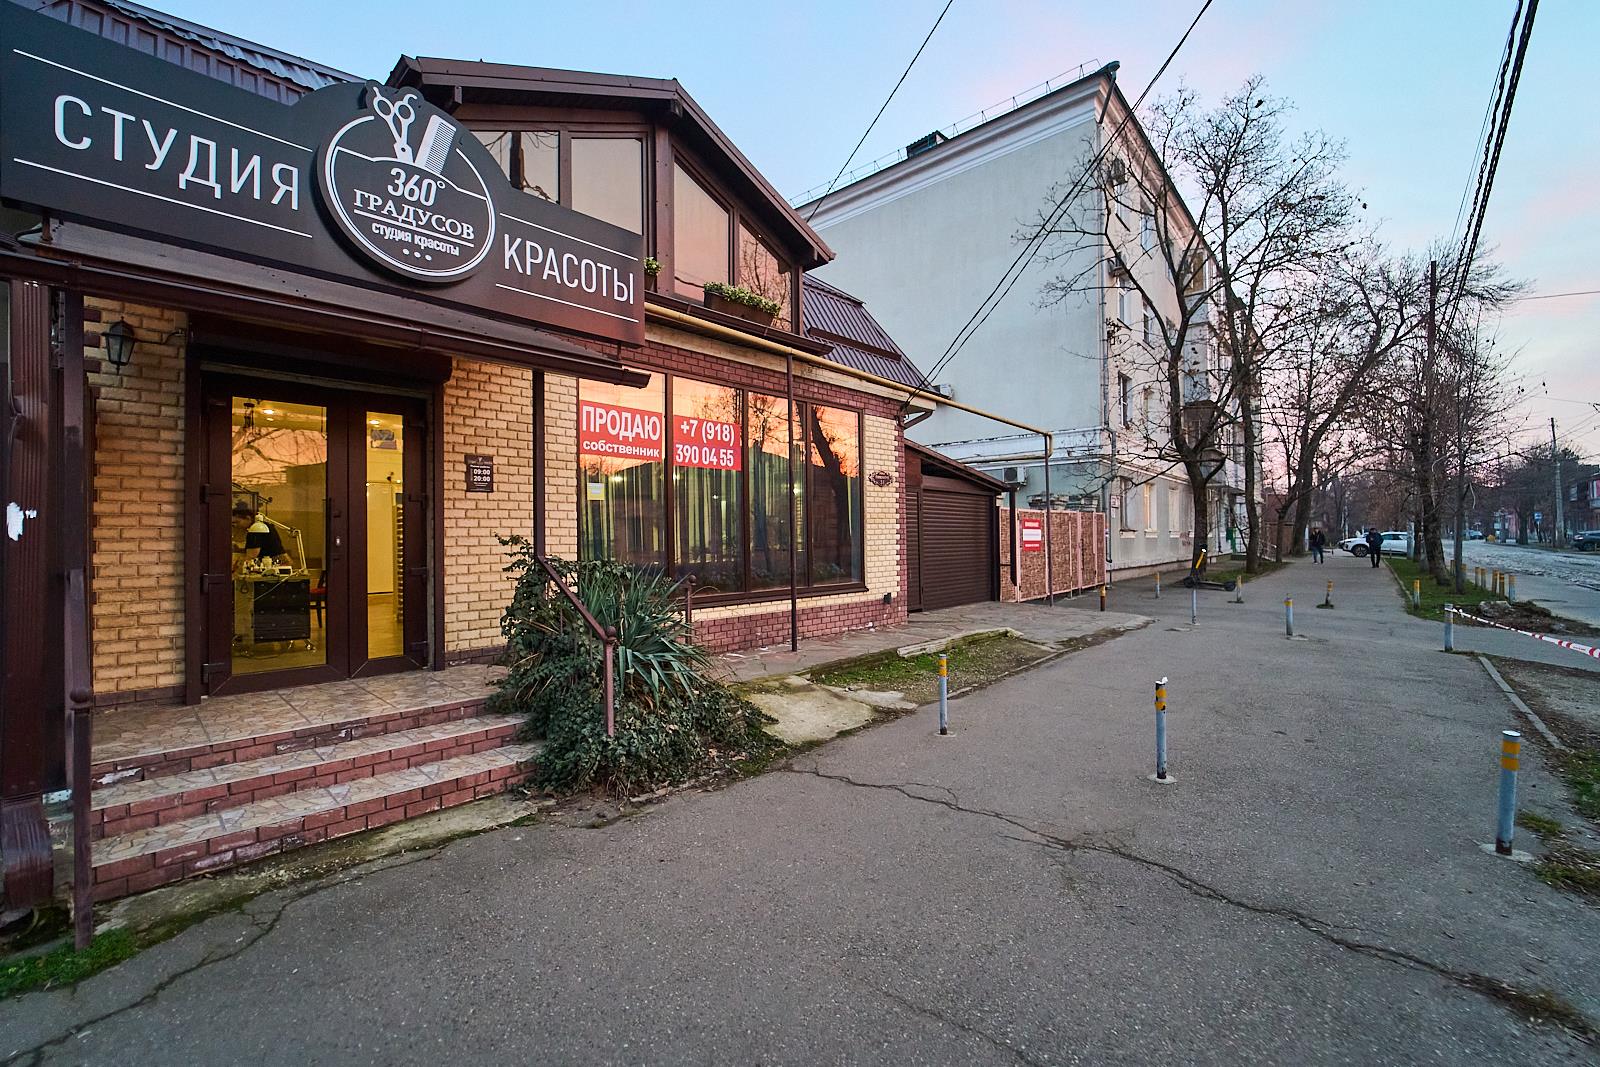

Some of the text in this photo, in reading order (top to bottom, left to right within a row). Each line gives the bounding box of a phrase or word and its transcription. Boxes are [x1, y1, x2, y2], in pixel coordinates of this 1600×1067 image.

[54, 94, 634, 305] СТУДИЯ КРАСОТЫ
[353, 188, 475, 240] ГРАДУСОВ
[371, 222, 460, 257] студия красоты
[582, 405, 661, 442] ПРОДАЮ
[680, 419, 735, 447] +7 (918)
[582, 440, 660, 458] собственник
[675, 444, 734, 467] 390 04 55
